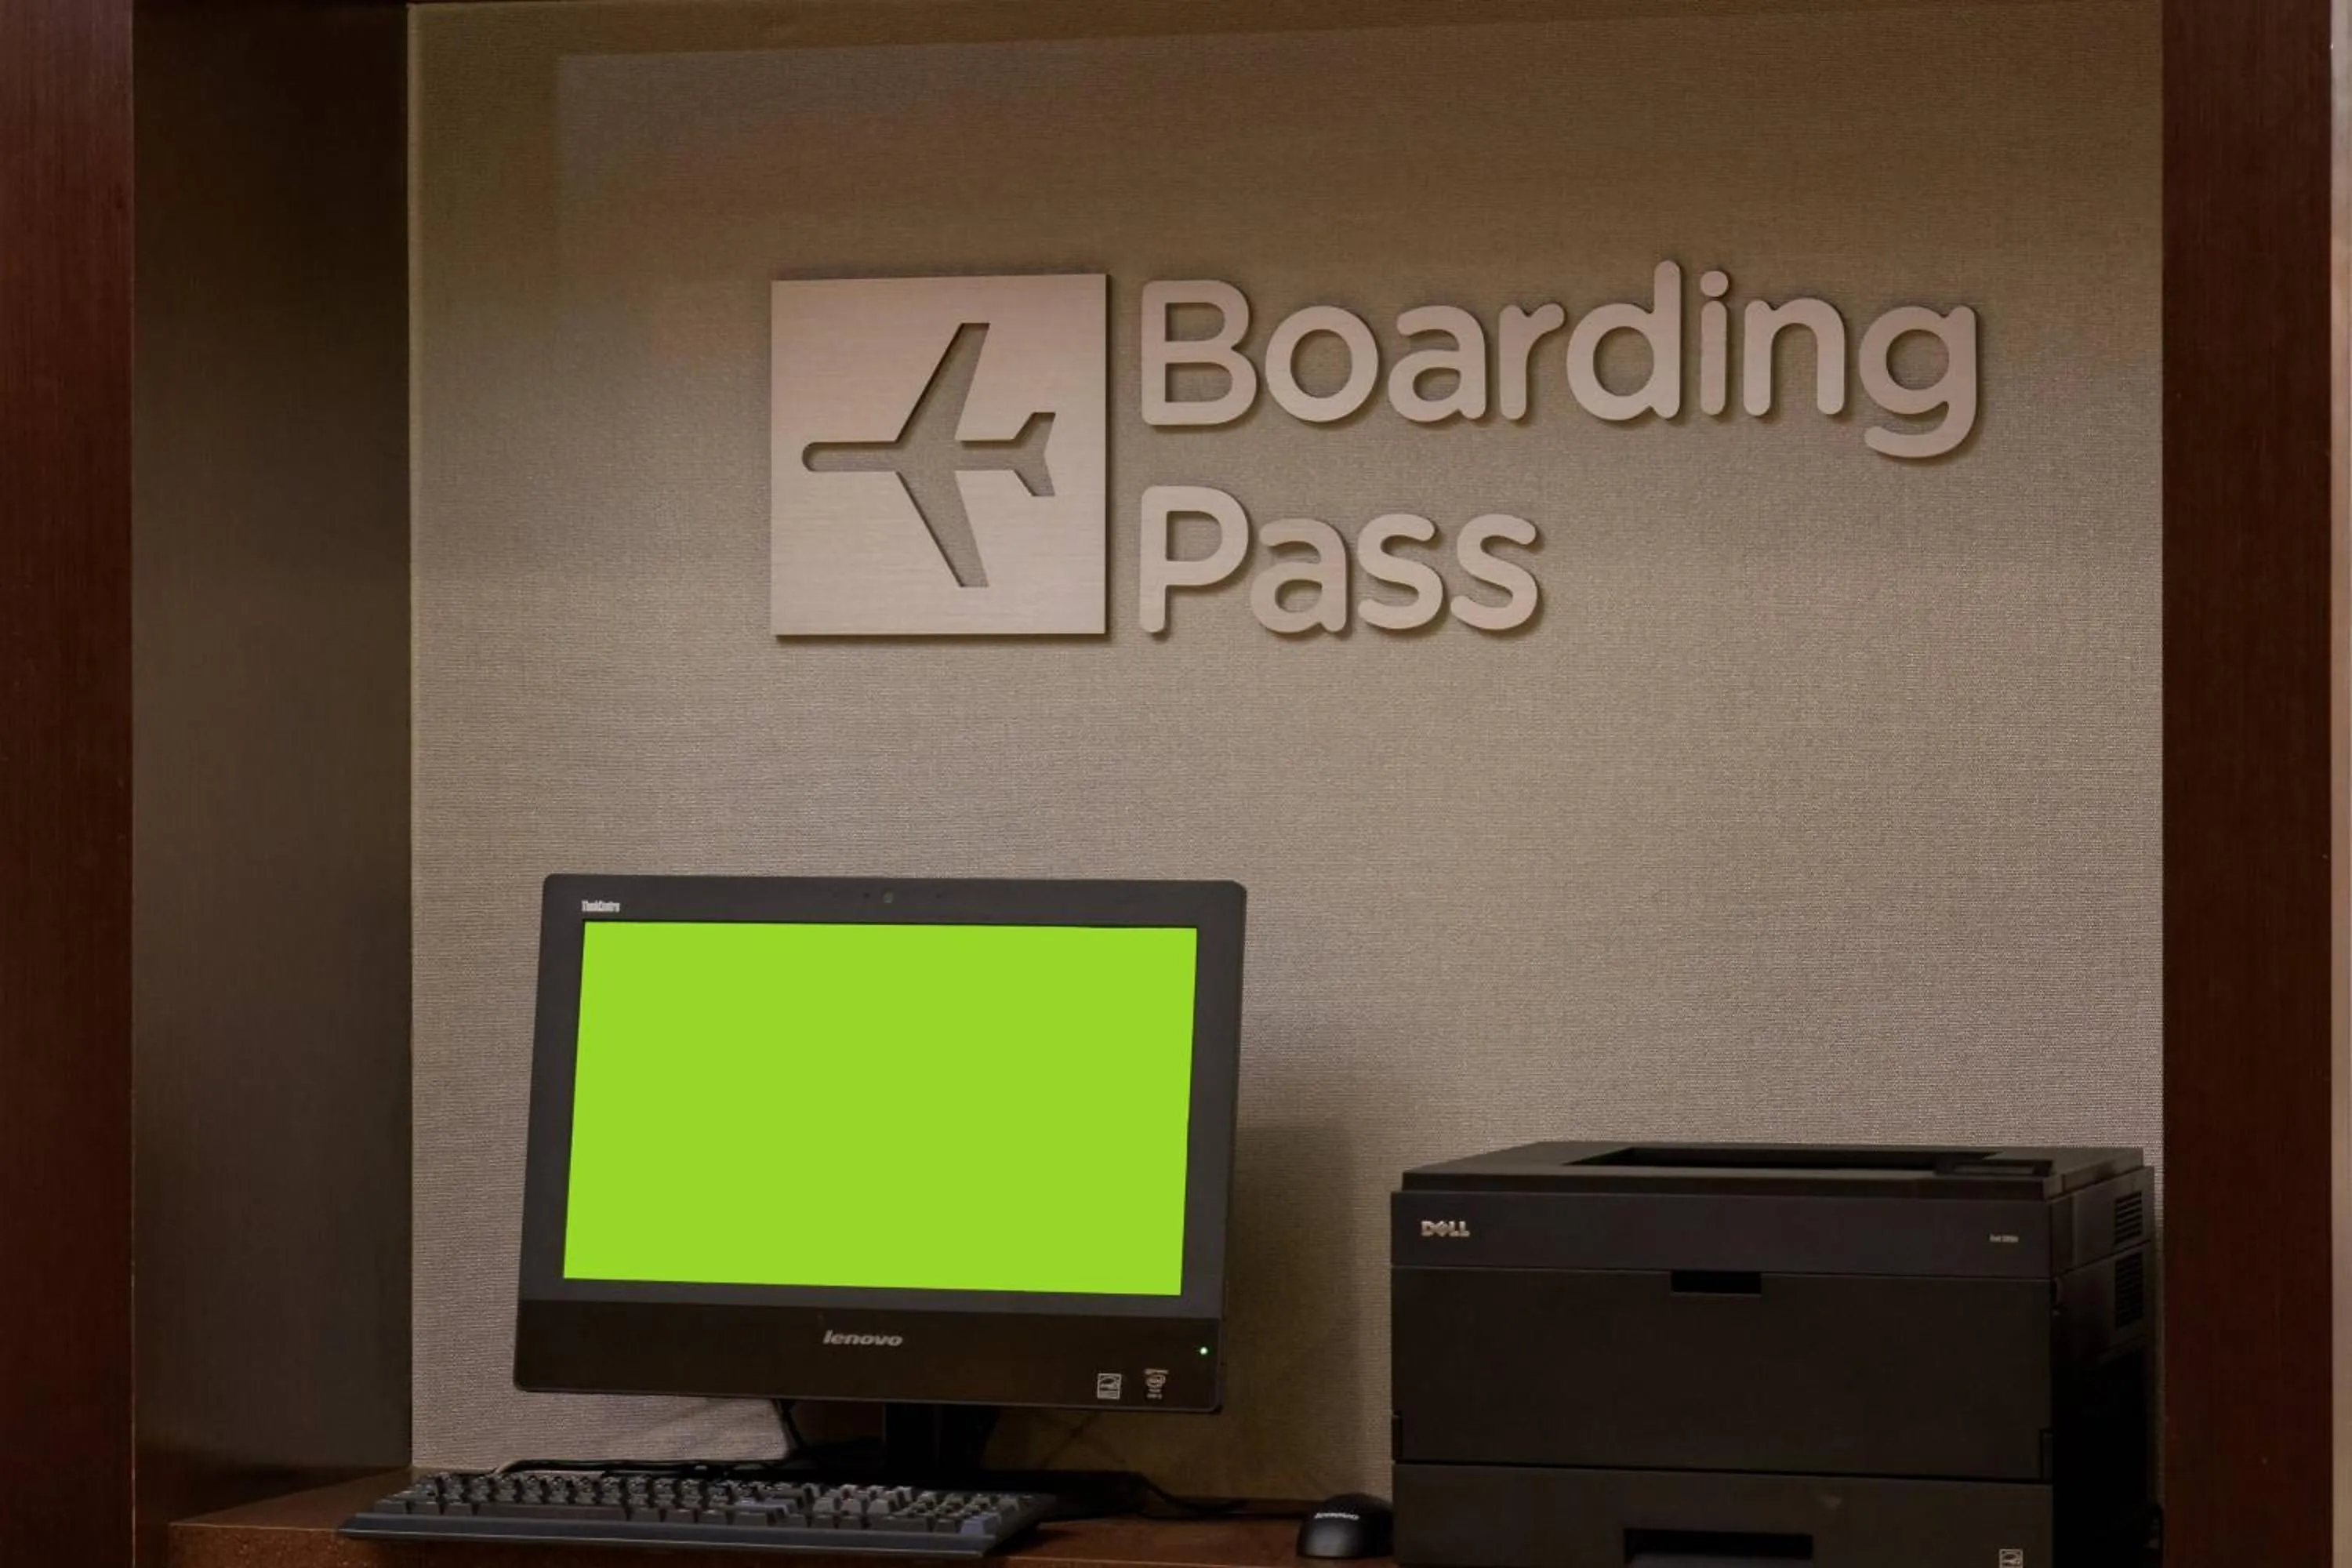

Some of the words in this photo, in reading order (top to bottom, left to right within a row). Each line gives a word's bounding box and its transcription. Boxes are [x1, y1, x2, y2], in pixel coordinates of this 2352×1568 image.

[1141, 260, 1978, 459] Boarding
[1139, 485, 1540, 633] Pass
[822, 1329, 903, 1347] lenovo
